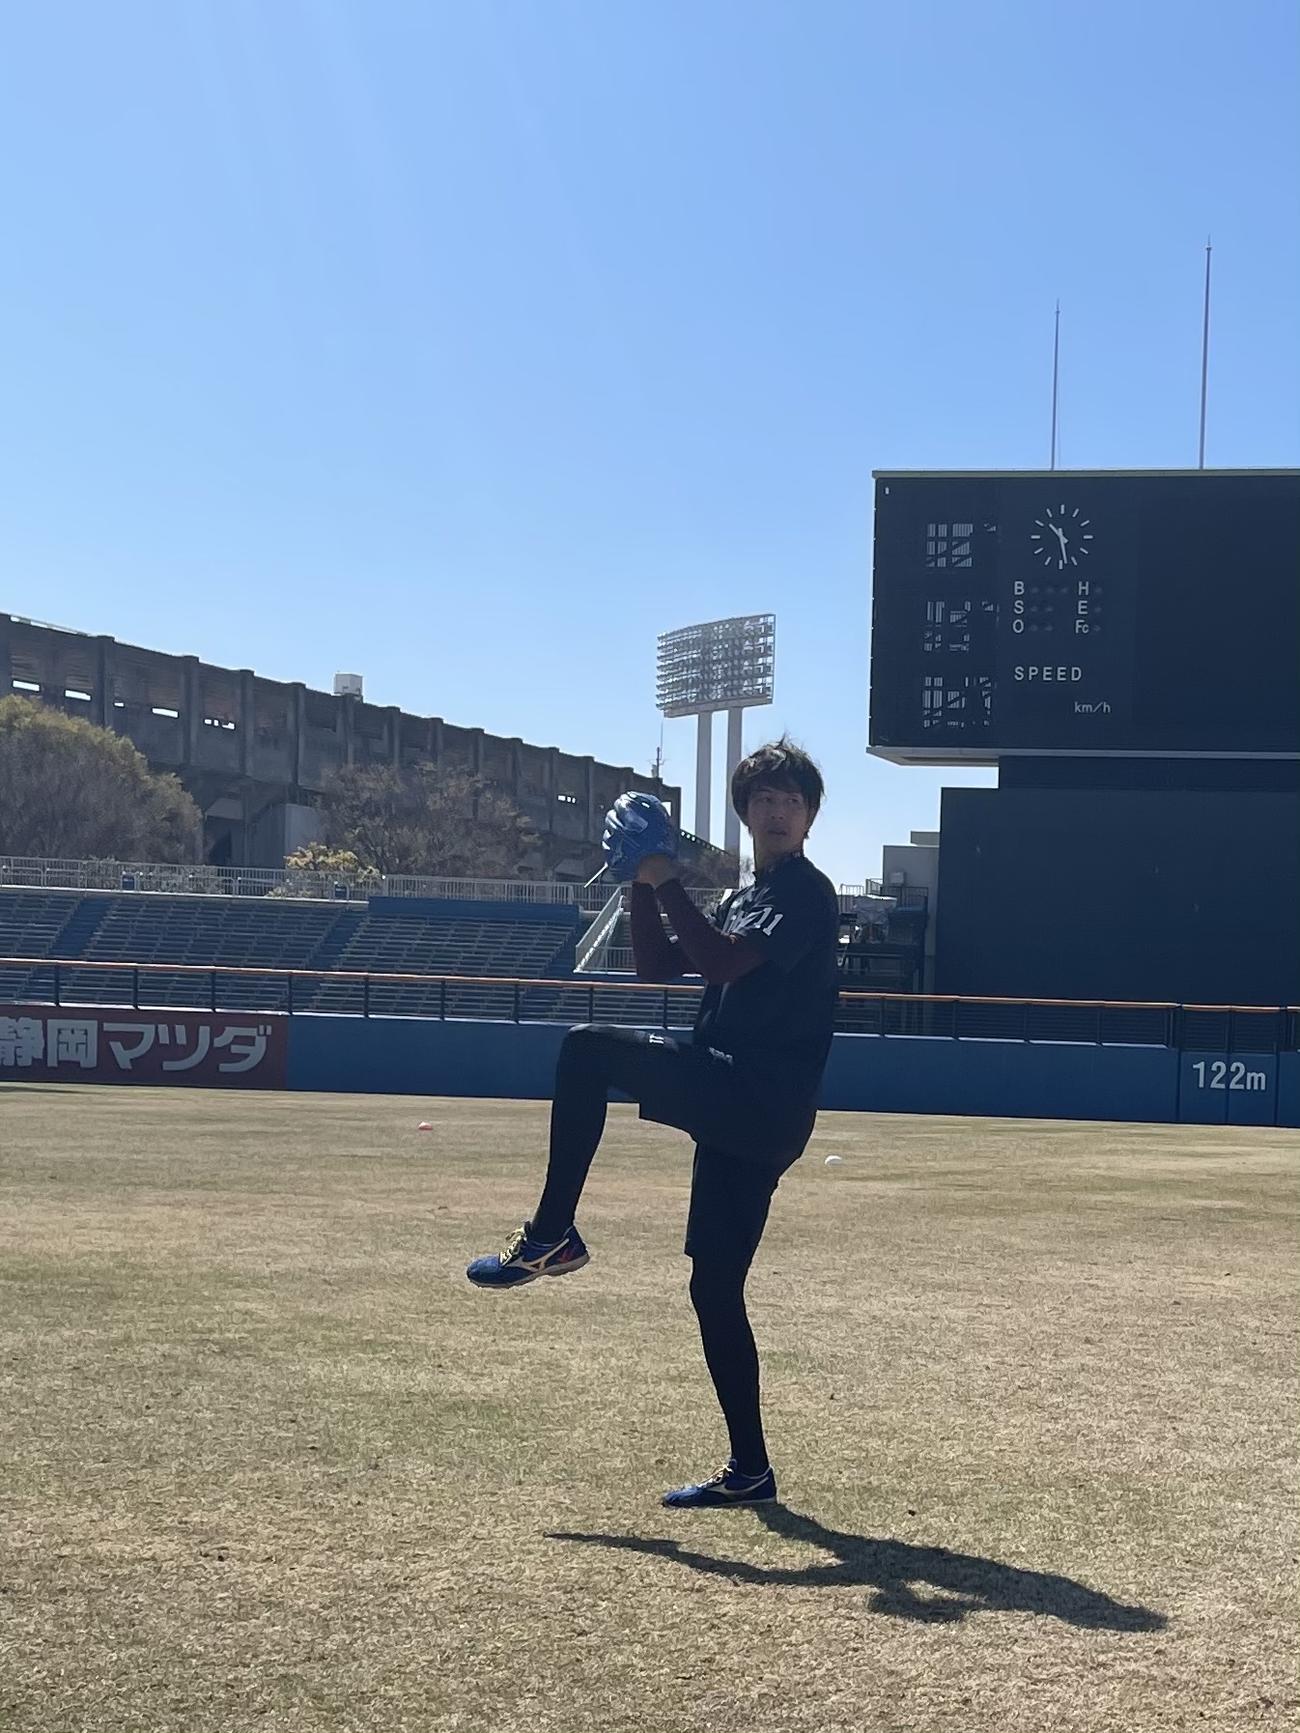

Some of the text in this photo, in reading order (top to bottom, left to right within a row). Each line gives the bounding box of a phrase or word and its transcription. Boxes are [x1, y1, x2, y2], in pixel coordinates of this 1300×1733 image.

[1014, 580, 1025, 595] B
[1078, 581, 1089, 596] H
[1013, 600, 1024, 614] S
[1077, 600, 1088, 615] E
[1012, 619, 1024, 634] O
[1075, 619, 1089, 634] Fc
[1014, 666, 1082, 681] SPEED
[1074, 701, 1111, 713] km/h
[0, 1016, 272, 1073] 静岡マツダ
[1192, 1061, 1267, 1091] 122m
